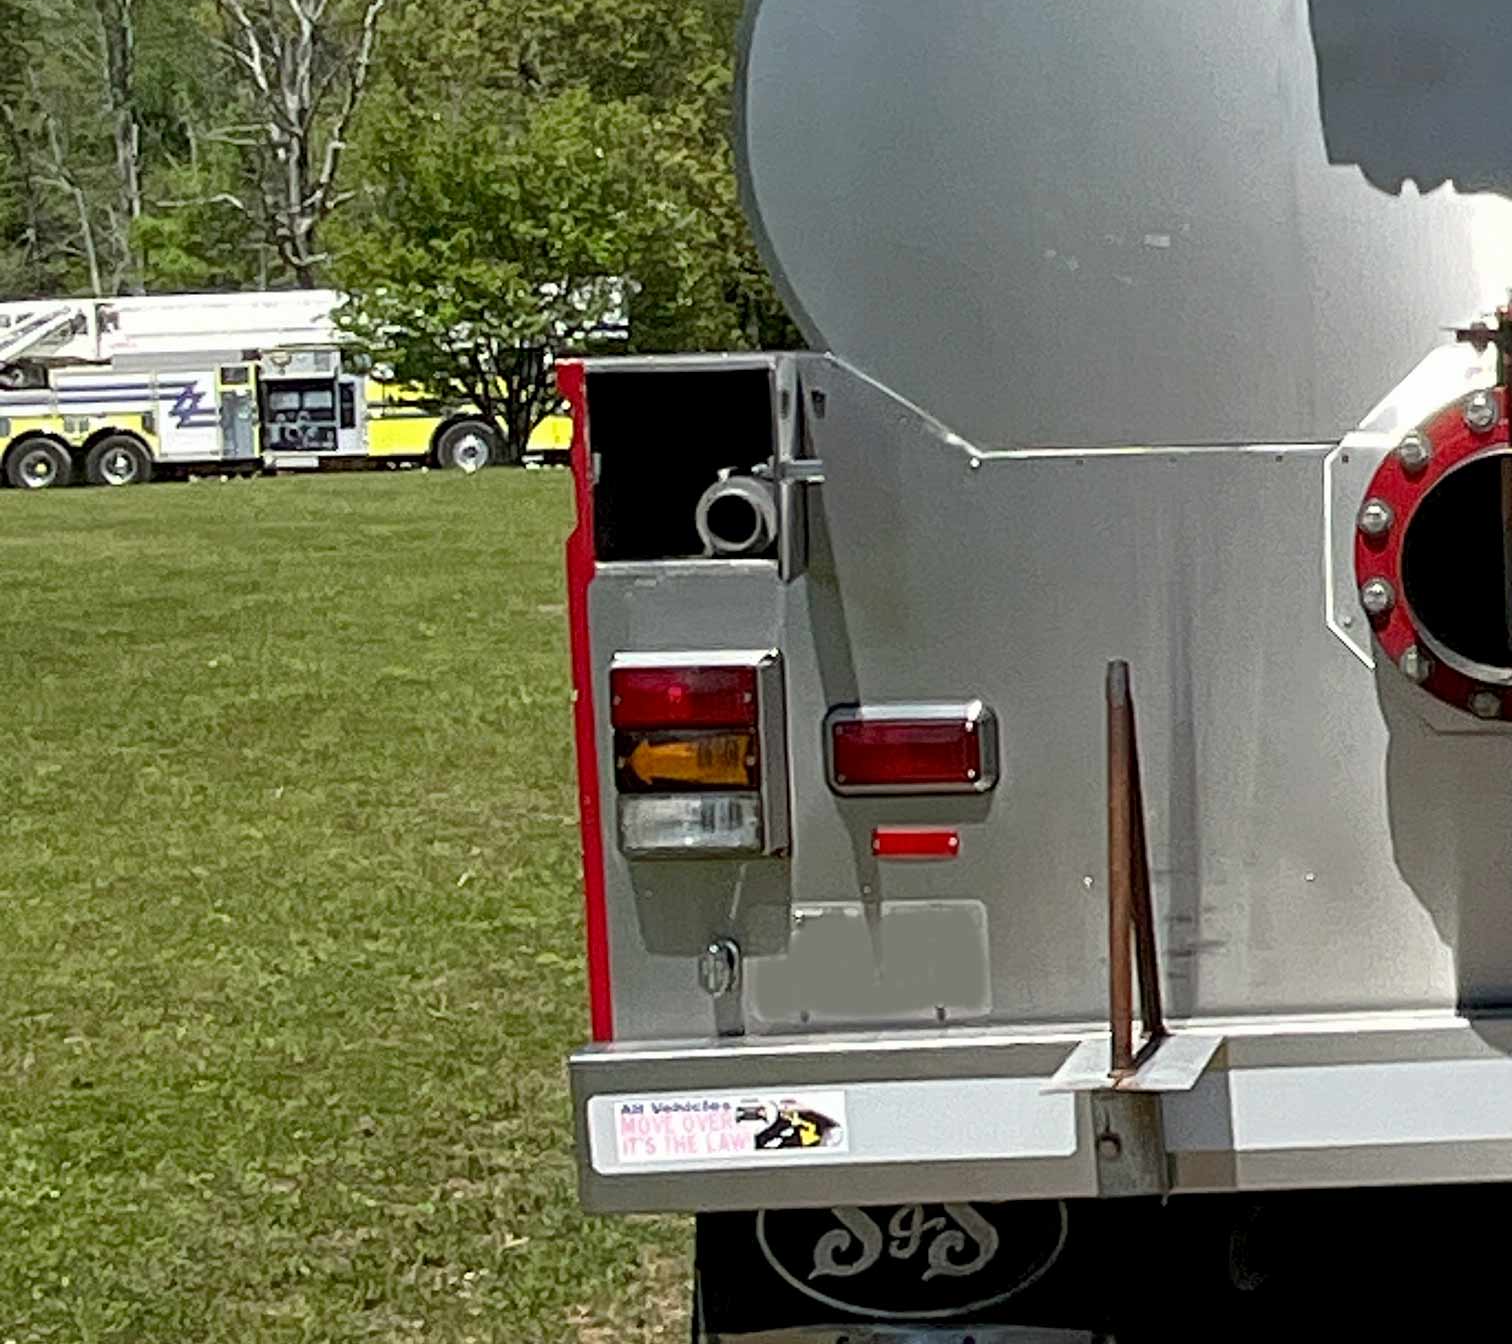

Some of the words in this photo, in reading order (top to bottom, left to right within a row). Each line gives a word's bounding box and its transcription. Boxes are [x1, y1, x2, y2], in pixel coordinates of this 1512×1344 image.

[620, 1113, 673, 1136] MOVE
[682, 1111, 733, 1133] OVER
[665, 1133, 698, 1154] THE
